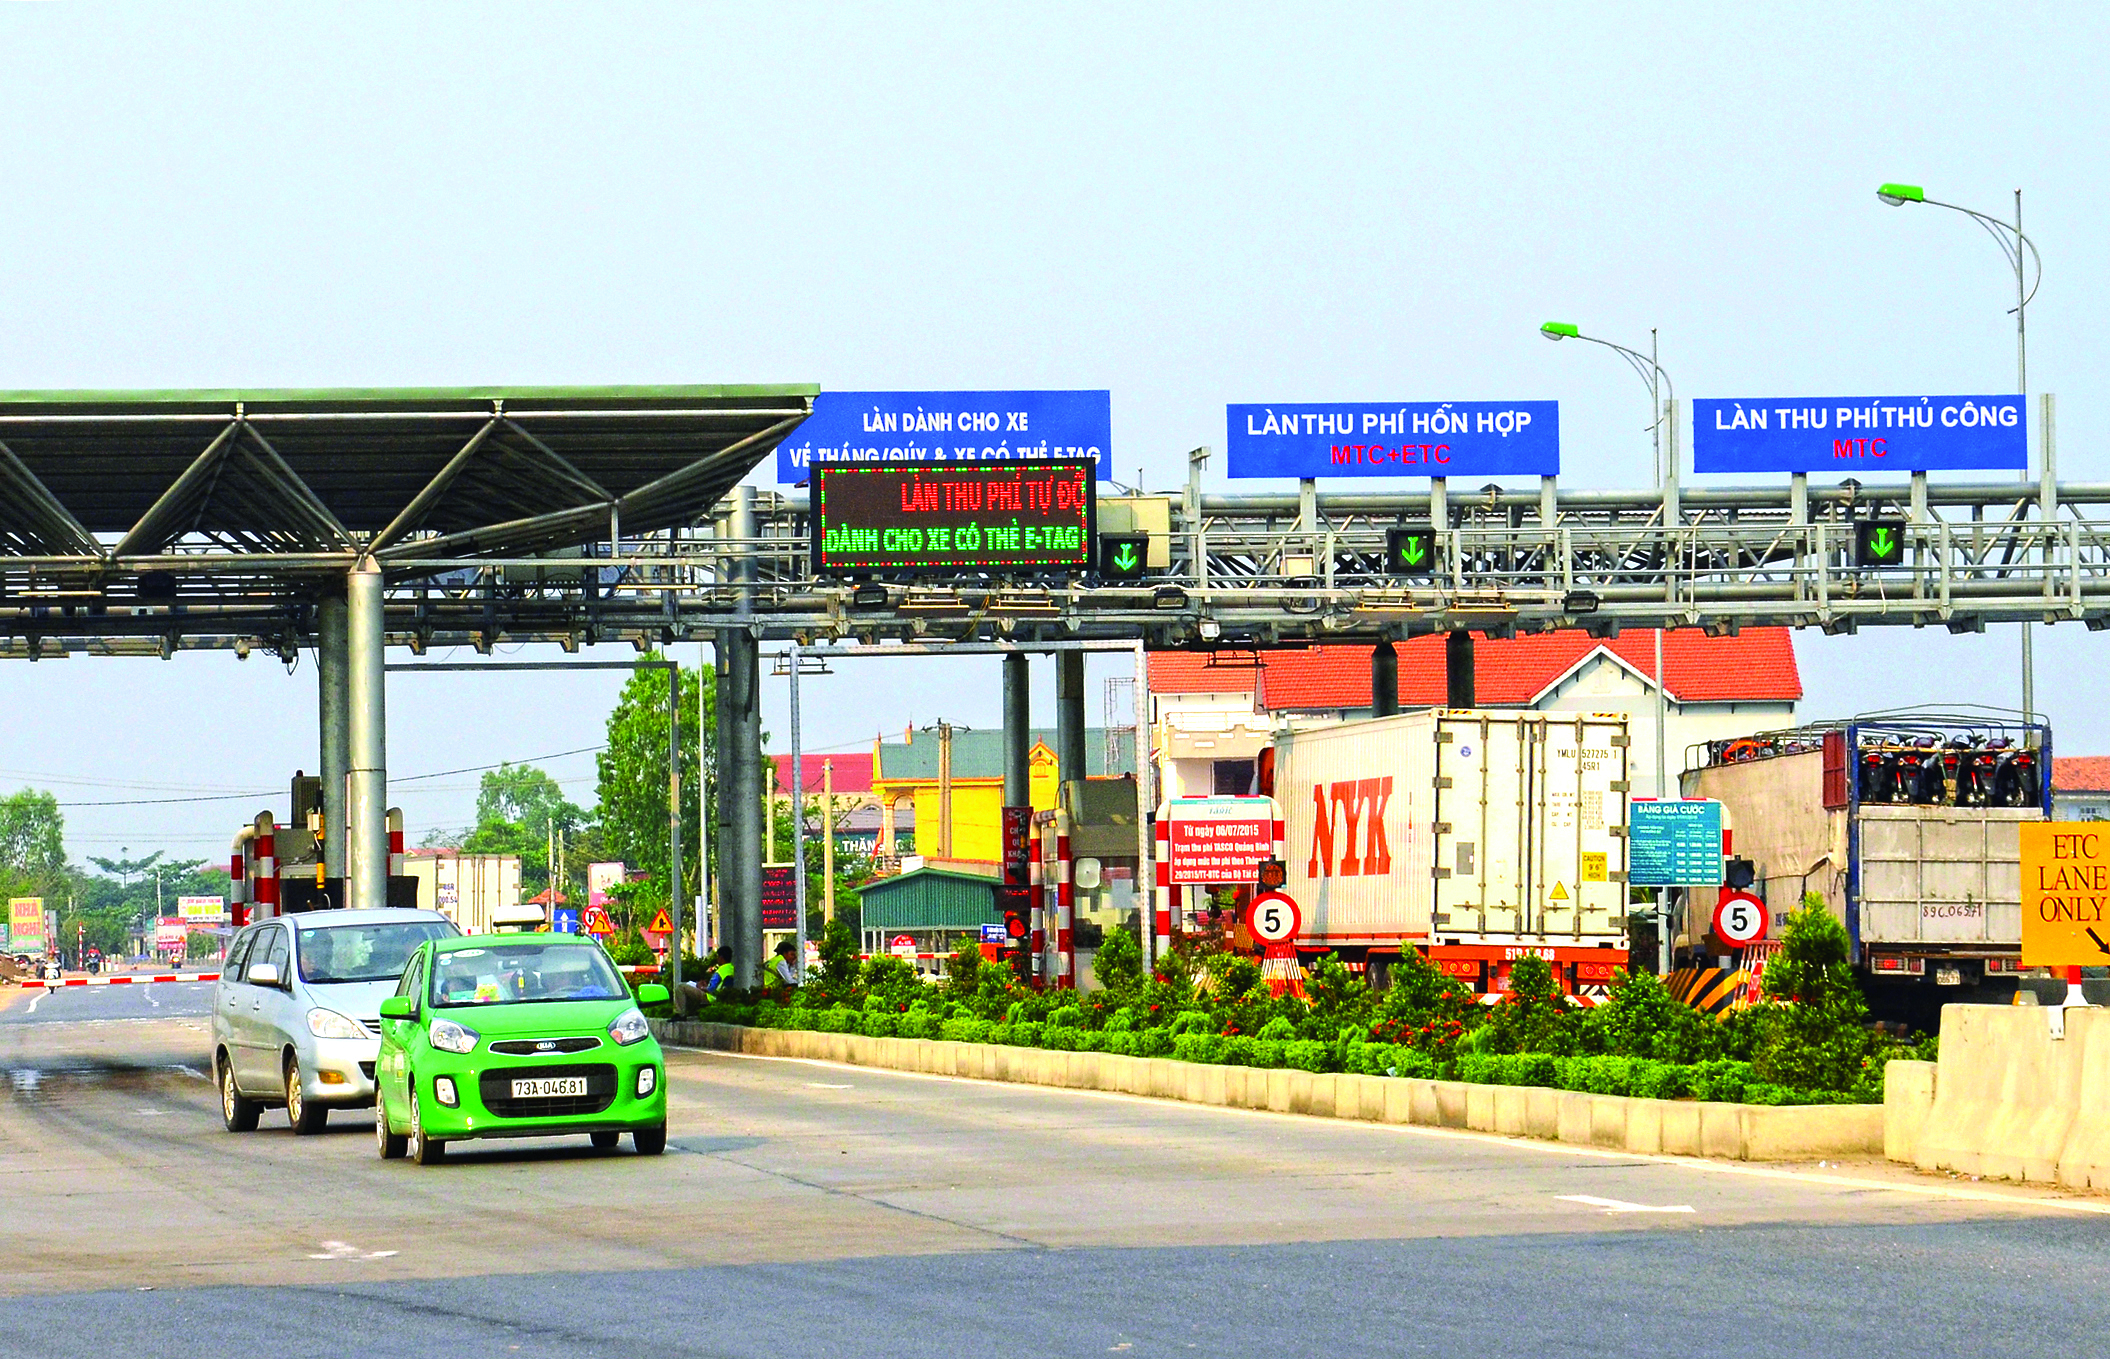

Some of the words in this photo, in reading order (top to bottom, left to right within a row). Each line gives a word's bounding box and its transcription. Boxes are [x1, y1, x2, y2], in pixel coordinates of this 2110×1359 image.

[863, 406, 897, 432] LÀN
[903, 406, 952, 432] DÀNH
[957, 412, 1000, 432] CHO
[1006, 412, 1028, 431] XE
[1247, 409, 1298, 435] LÀN
[1301, 413, 1354, 435] THU
[1362, 408, 1407, 434] PHÍ
[1413, 403, 1468, 434] HỖN
[1477, 411, 1532, 437] HỢP
[1716, 403, 1767, 430] LÀN
[1775, 408, 1828, 429] THU
[1836, 401, 1880, 429] PHÍ
[1881, 396, 1933, 428] THỦ
[1940, 401, 2018, 427] CÔNG
[1331, 444, 1451, 465] MTC+ETC
[1833, 438, 1887, 459] MTC
[901, 474, 938, 511] LÀN
[942, 481, 982, 510] THU
[987, 472, 1022, 510] PHÍ
[826, 522, 879, 552] DÀNH
[883, 528, 923, 552] CHO
[926, 527, 951, 551] XE
[955, 521, 981, 550] CÓ
[1025, 525, 1080, 549] E-TAG
[1557, 749, 1576, 758] YMLU
[1582, 749, 1609, 758] 527275
[1583, 762, 1600, 770] 45R1
[1638, 803, 1662, 814] BẢNG
[1663, 804, 1679, 814] GIÁ
[1195, 825, 1214, 838] ngày
[1216, 824, 1259, 837] 06/07/2015
[1308, 776, 1393, 878] NYK
[2052, 834, 2099, 859] ETC
[2038, 865, 2108, 890] LANE
[1264, 909, 1281, 933] 5
[1732, 907, 1748, 932] 5
[2040, 896, 2108, 922] ONLY
[515, 1080, 584, 1096] 73A-046.81
